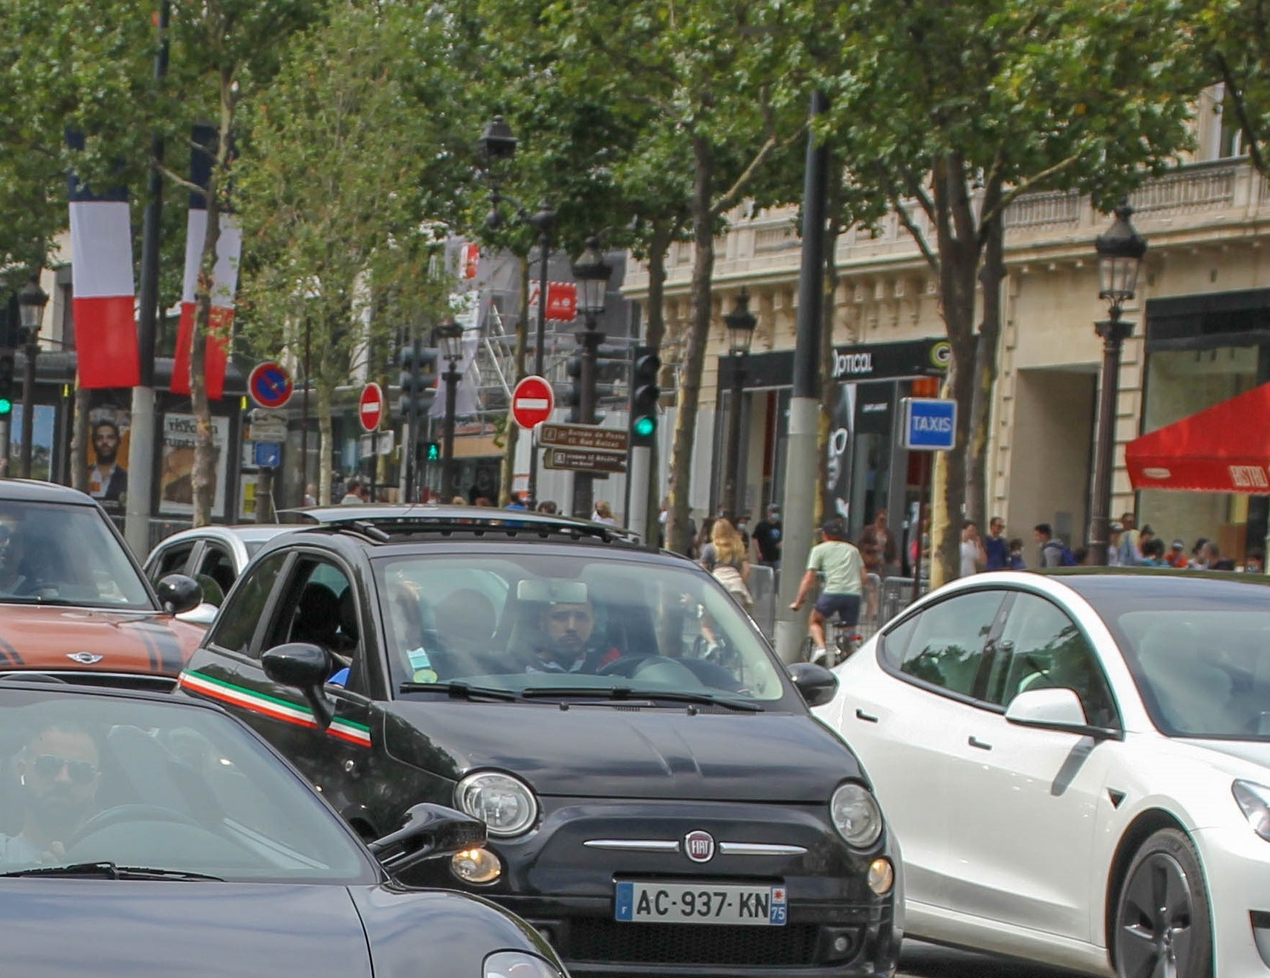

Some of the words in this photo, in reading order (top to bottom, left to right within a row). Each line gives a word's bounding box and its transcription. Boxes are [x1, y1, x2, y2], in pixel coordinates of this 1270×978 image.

[913, 416, 952, 432] TAXIS
[691, 840, 710, 855] FIAT
[771, 906, 785, 920] 75
